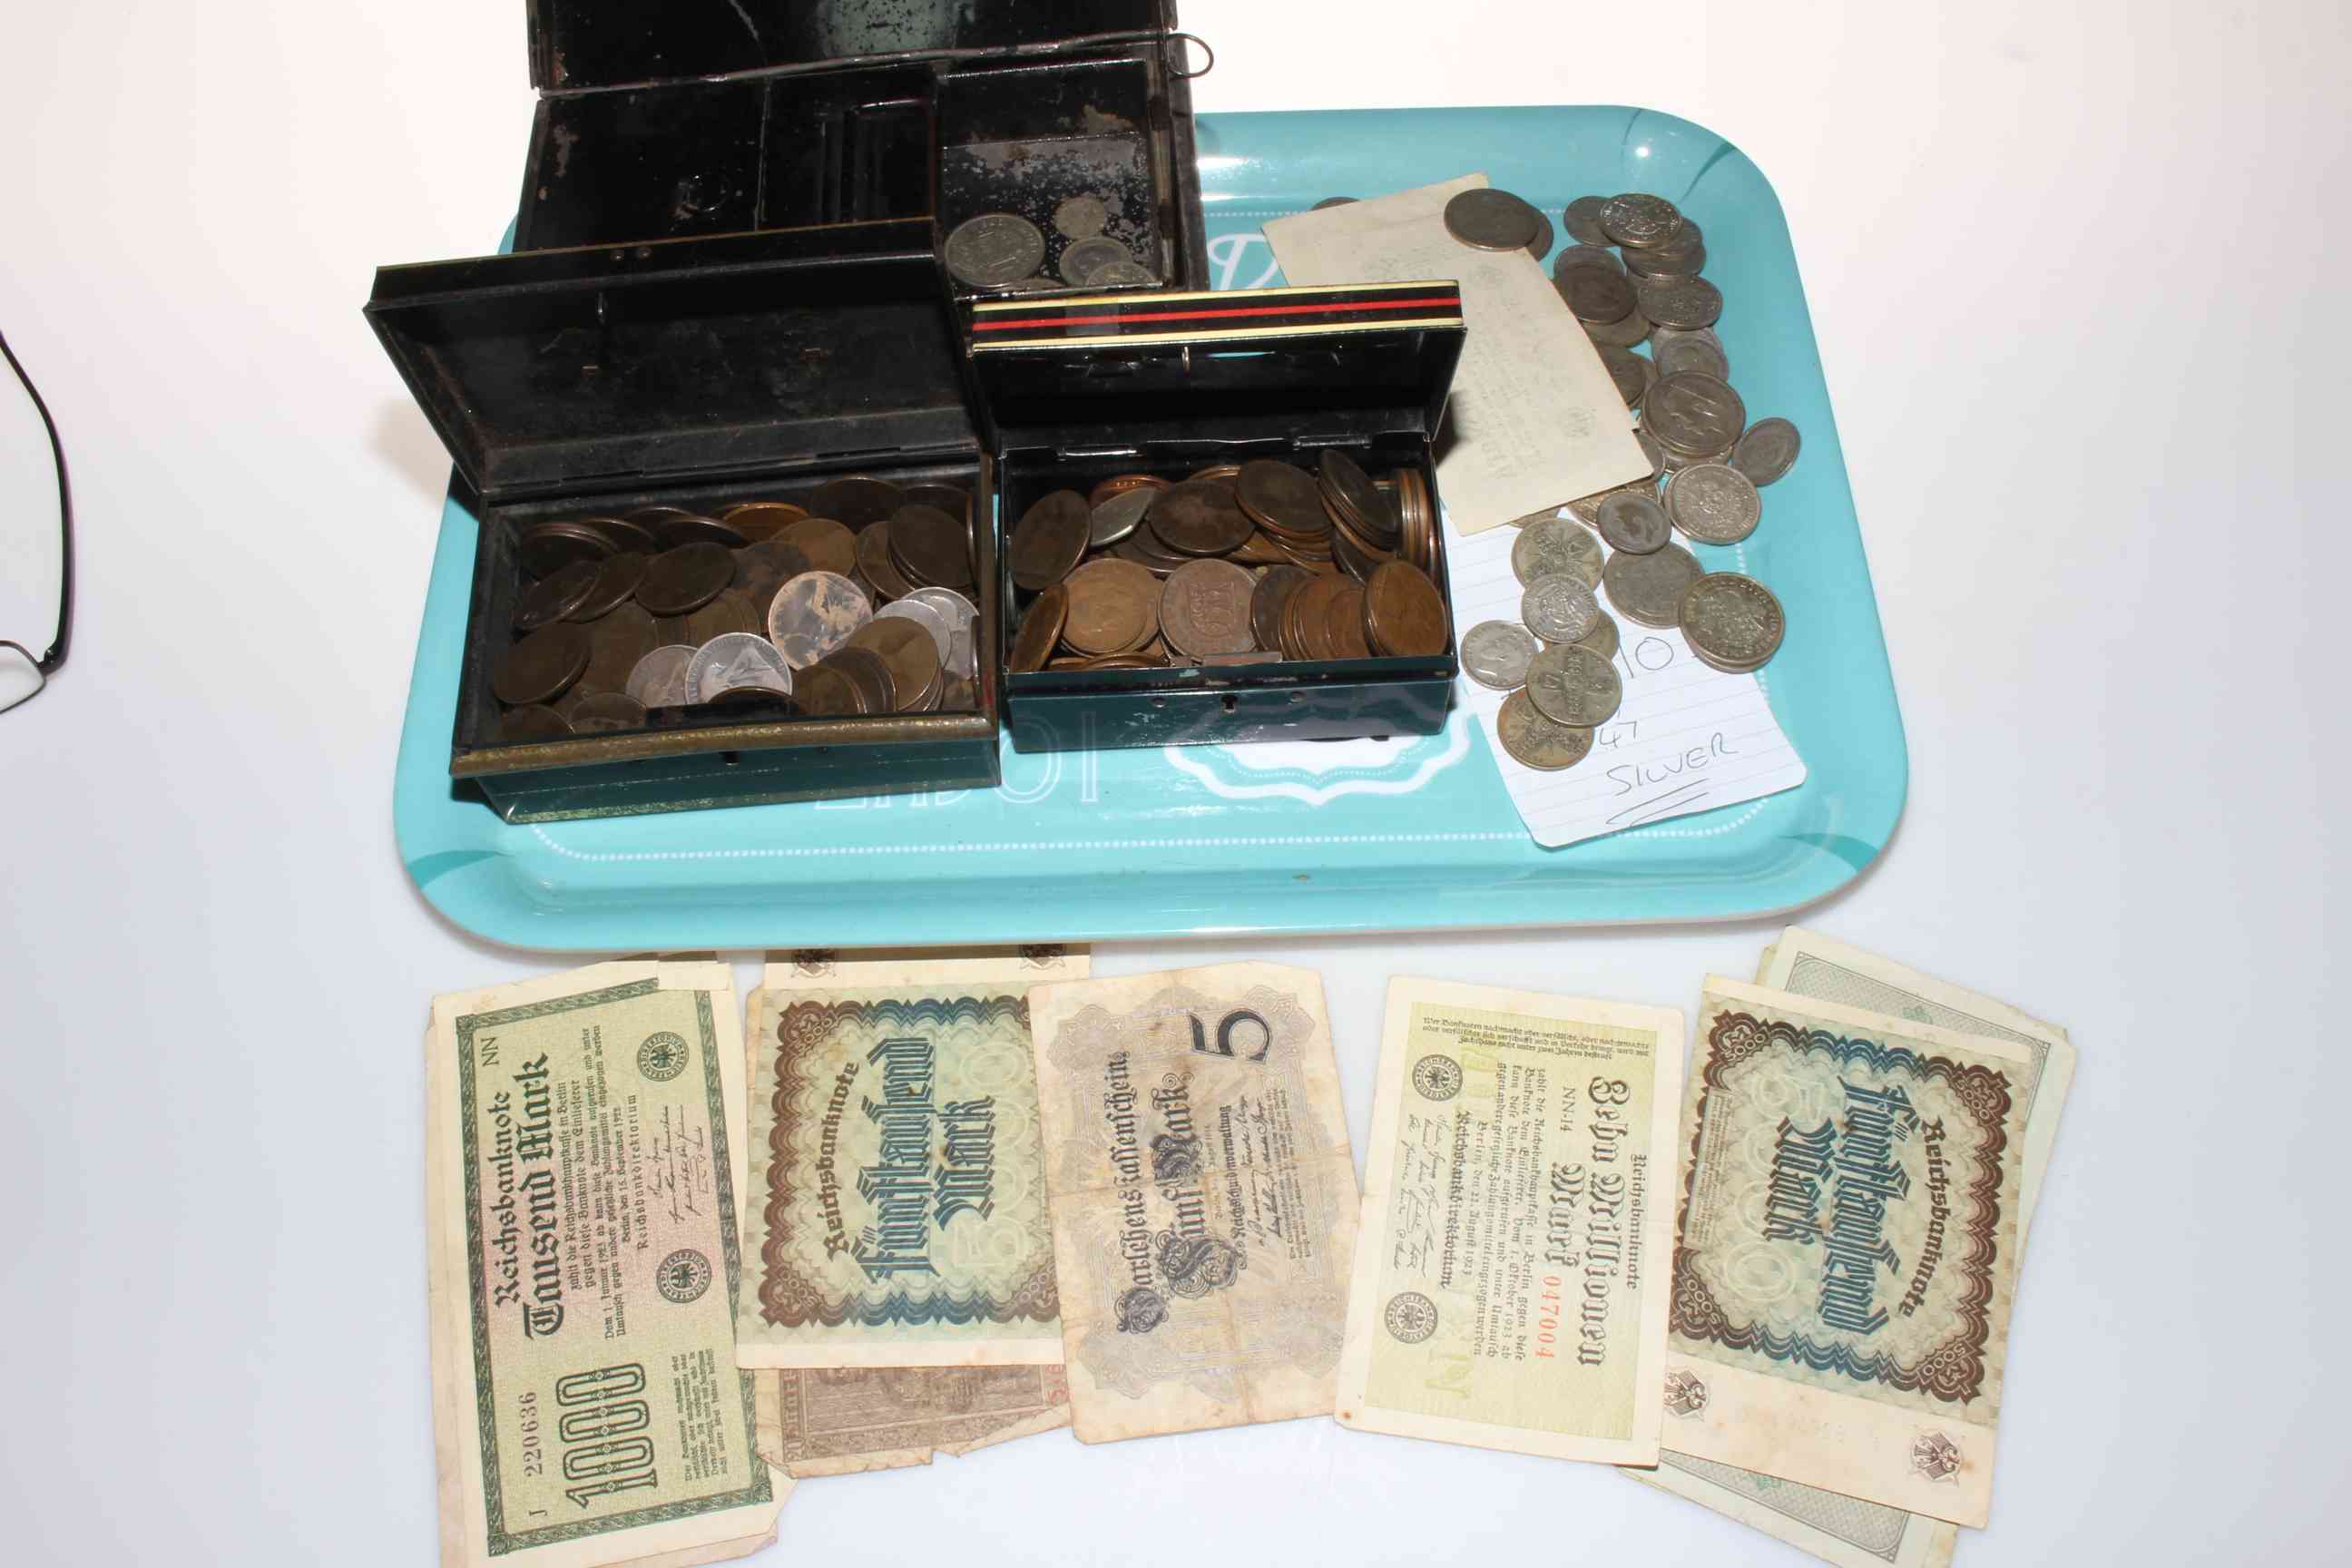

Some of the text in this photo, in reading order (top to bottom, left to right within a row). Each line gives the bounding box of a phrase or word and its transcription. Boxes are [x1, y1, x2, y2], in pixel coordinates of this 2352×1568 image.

[1606, 732, 1740, 797] SILVER
[480, 1036, 499, 1066] NN
[1190, 1008, 1272, 1063] 5
[1721, 1030, 1767, 1062] 5000
[556, 1082, 568, 1112] Berlin
[1535, 1097, 1544, 1112] die
[1536, 1067, 1547, 1093] zahlt
[1560, 1086, 1576, 1132] NN-14
[1955, 1077, 1991, 1122] 5000
[574, 1140, 585, 1161] dem
[628, 1094, 648, 1249] Reichsbankdirektorium
[816, 1061, 859, 1261] Reichsbanknote
[854, 1037, 940, 1284] Fünftausend
[934, 1094, 995, 1231] Mark
[1762, 1116, 1836, 1245] Mark
[488, 1093, 519, 1305] Reichsbanknote
[514, 1054, 564, 1337] Tausend Mark
[576, 1167, 589, 1219] Banknote
[1151, 1073, 1248, 1298] Fünf Mark
[1441, 1111, 1470, 1287] Reichsbankdirektorium
[1545, 1162, 1584, 1267] Mark
[1818, 1075, 1920, 1336] Fünftausend
[1524, 1234, 1533, 1245] in
[1578, 1076, 1629, 1365] Zehn Millionen
[1627, 1154, 1647, 1289] Reichsbanknote
[1898, 1115, 1952, 1318] Reichsbanknote
[583, 1254, 596, 1288] gegen
[1462, 1250, 1473, 1276] 1923
[1521, 1251, 1534, 1289] Berlin
[1502, 1312, 1512, 1338] 1923
[1516, 1296, 1528, 1328] gegen
[1535, 1276, 1561, 1357] 047004
[1686, 1277, 1722, 1326] 5000
[1921, 1343, 1966, 1377] 5000
[519, 1391, 543, 1476] 220636
[556, 1364, 656, 1505] 1000
